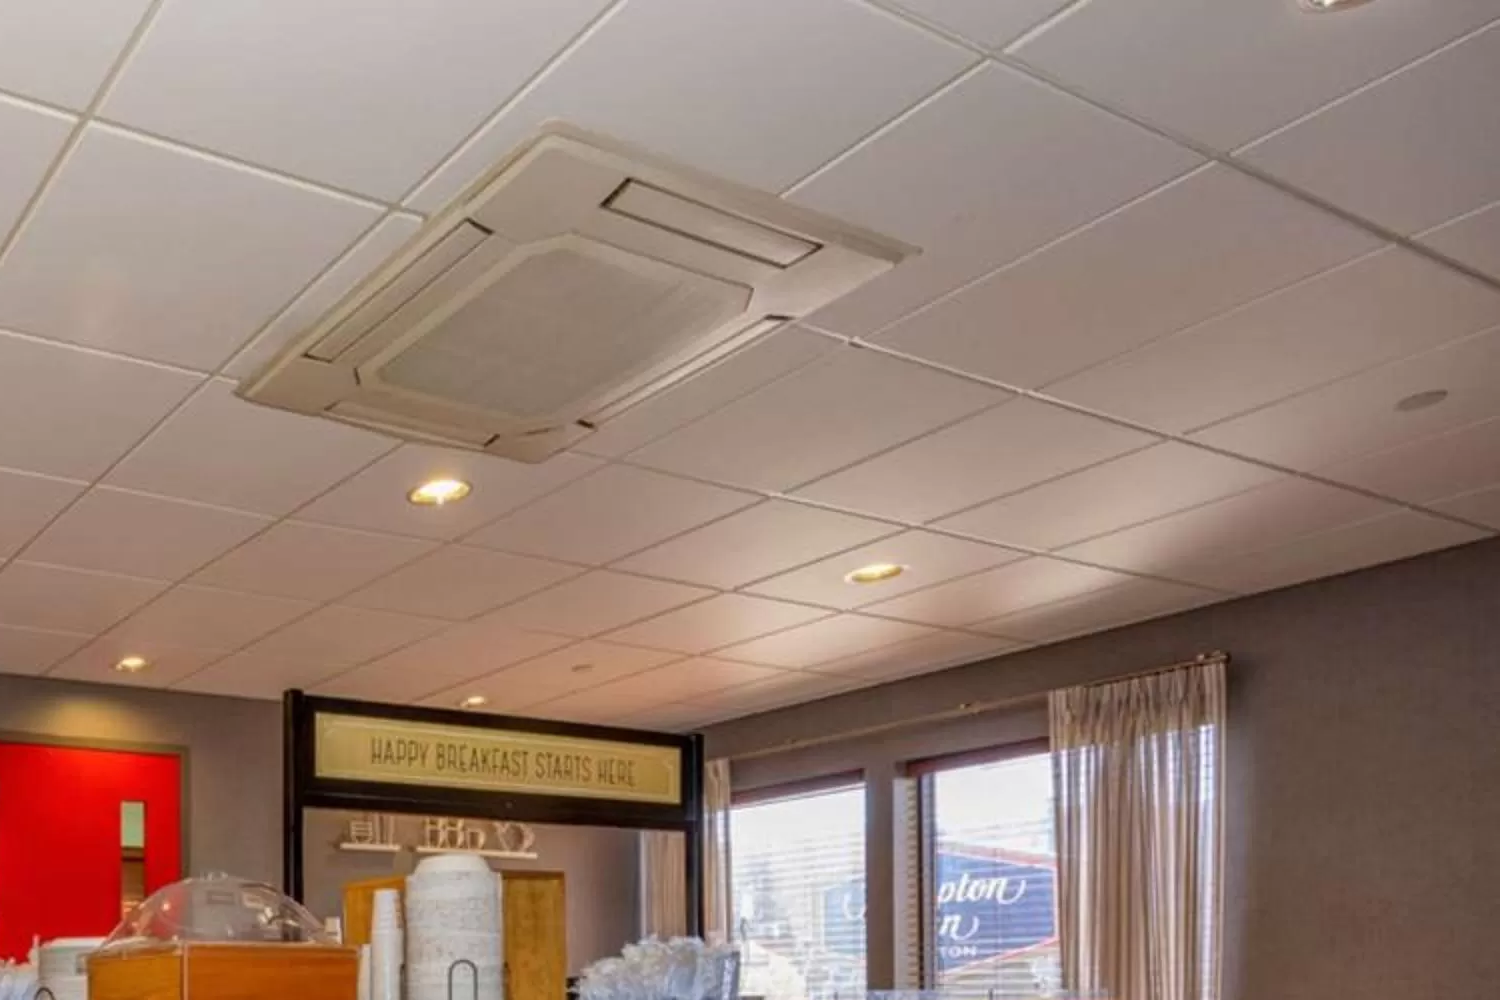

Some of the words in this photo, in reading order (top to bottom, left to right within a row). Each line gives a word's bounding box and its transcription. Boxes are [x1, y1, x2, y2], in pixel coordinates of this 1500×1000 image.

[370, 736, 429, 768] HAPPY
[435, 742, 529, 780] BREAKFAST
[535, 751, 593, 782] STARTS
[597, 758, 637, 787] HERE
[937, 873, 1027, 909] pton
[940, 946, 977, 959] TON
